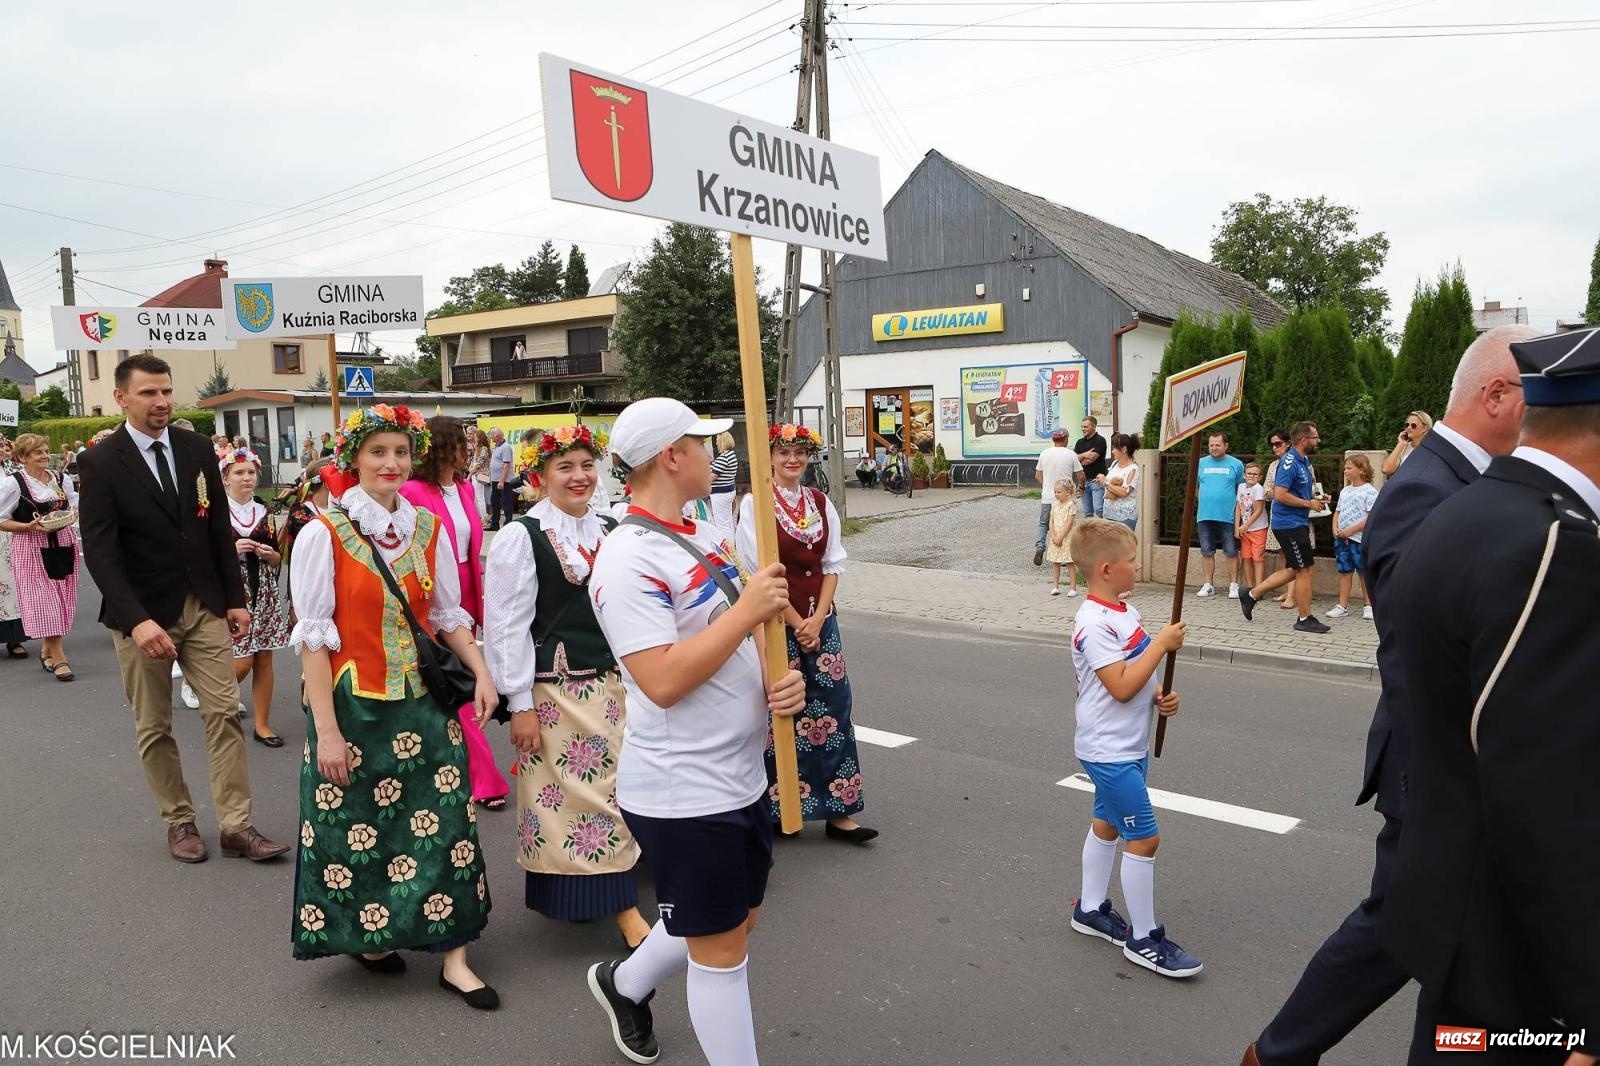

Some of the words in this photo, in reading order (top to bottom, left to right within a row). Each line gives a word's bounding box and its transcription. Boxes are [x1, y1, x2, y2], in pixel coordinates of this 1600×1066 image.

[729, 124, 840, 191] GMINA
[697, 169, 870, 246] Krzanowice
[317, 284, 385, 304] GMINA
[137, 311, 215, 326] GMINA
[283, 311, 336, 328] Kuźnia
[340, 308, 418, 326] Raciborska
[911, 311, 988, 332] LEWIATAN
[149, 328, 207, 344] Nędza
[1182, 376, 1231, 419] BOJANÓW
